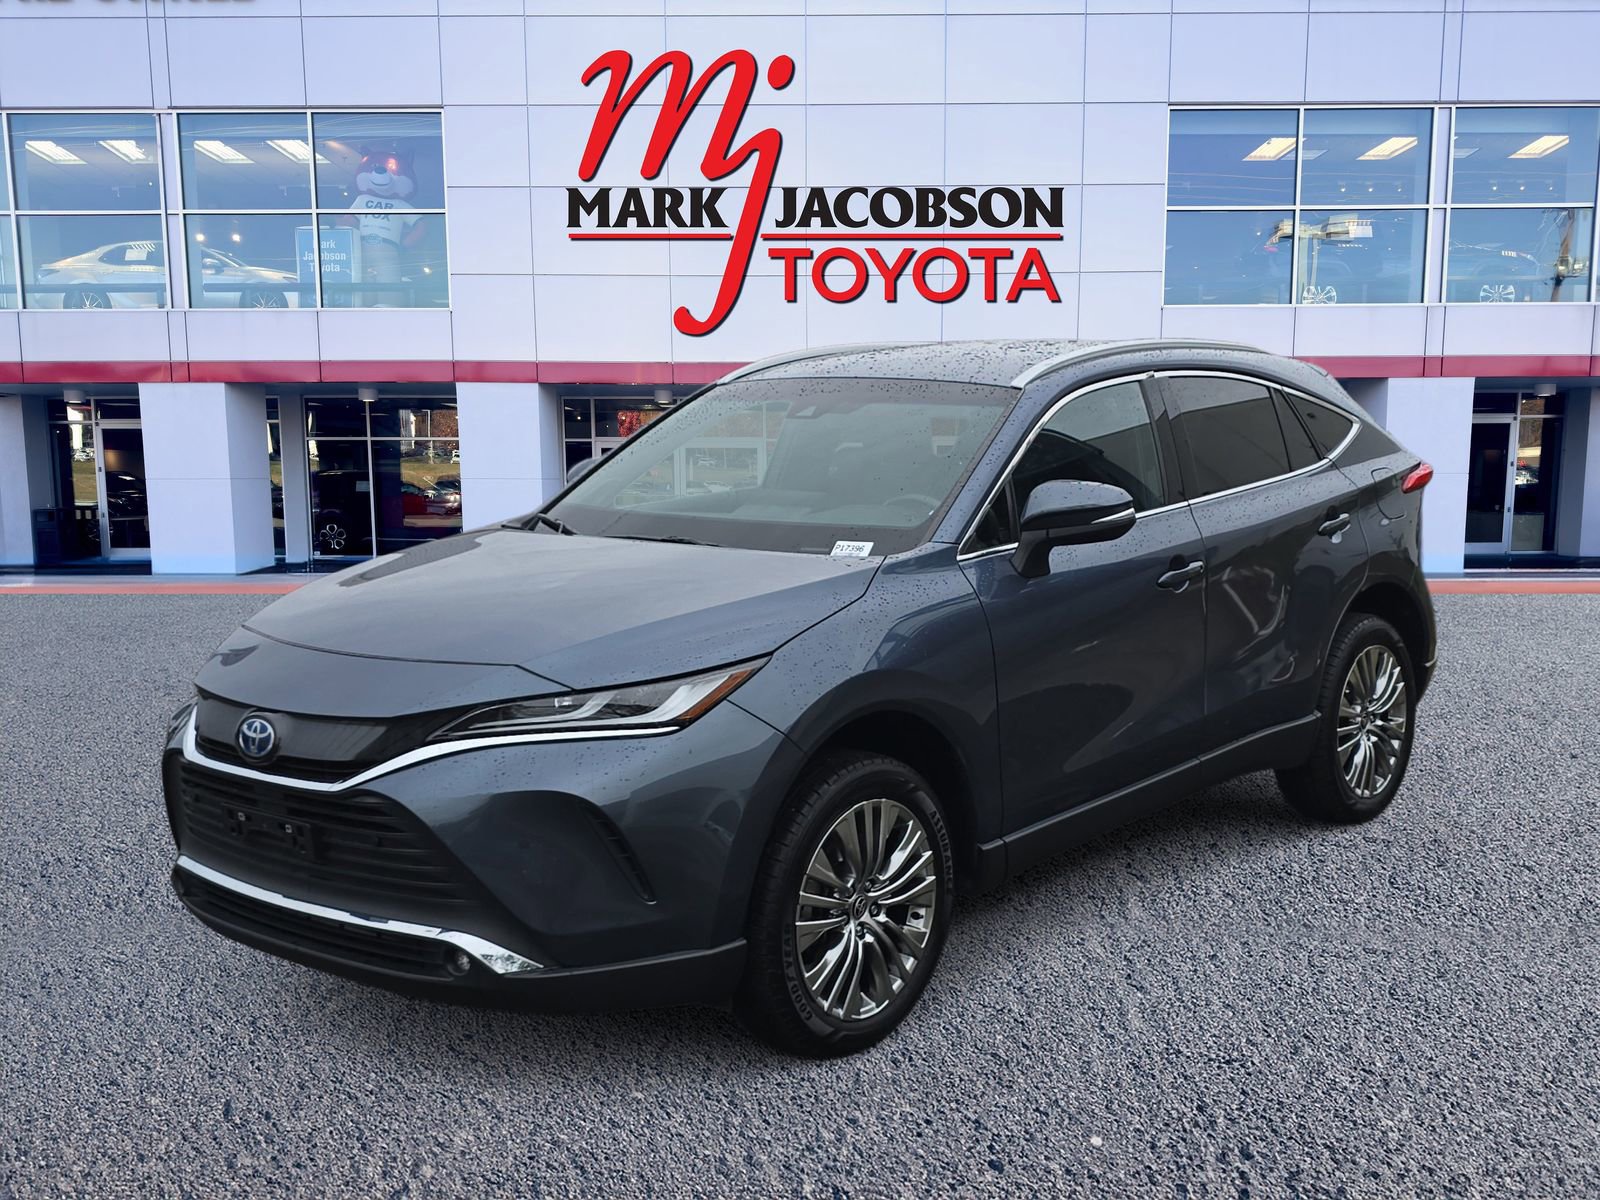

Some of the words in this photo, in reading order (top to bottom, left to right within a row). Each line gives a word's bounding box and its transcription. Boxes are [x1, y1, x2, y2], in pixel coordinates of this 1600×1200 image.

[566, 187, 729, 228] MARK
[775, 187, 1065, 228] JACOBSON
[768, 247, 1063, 304] TOYOTA
